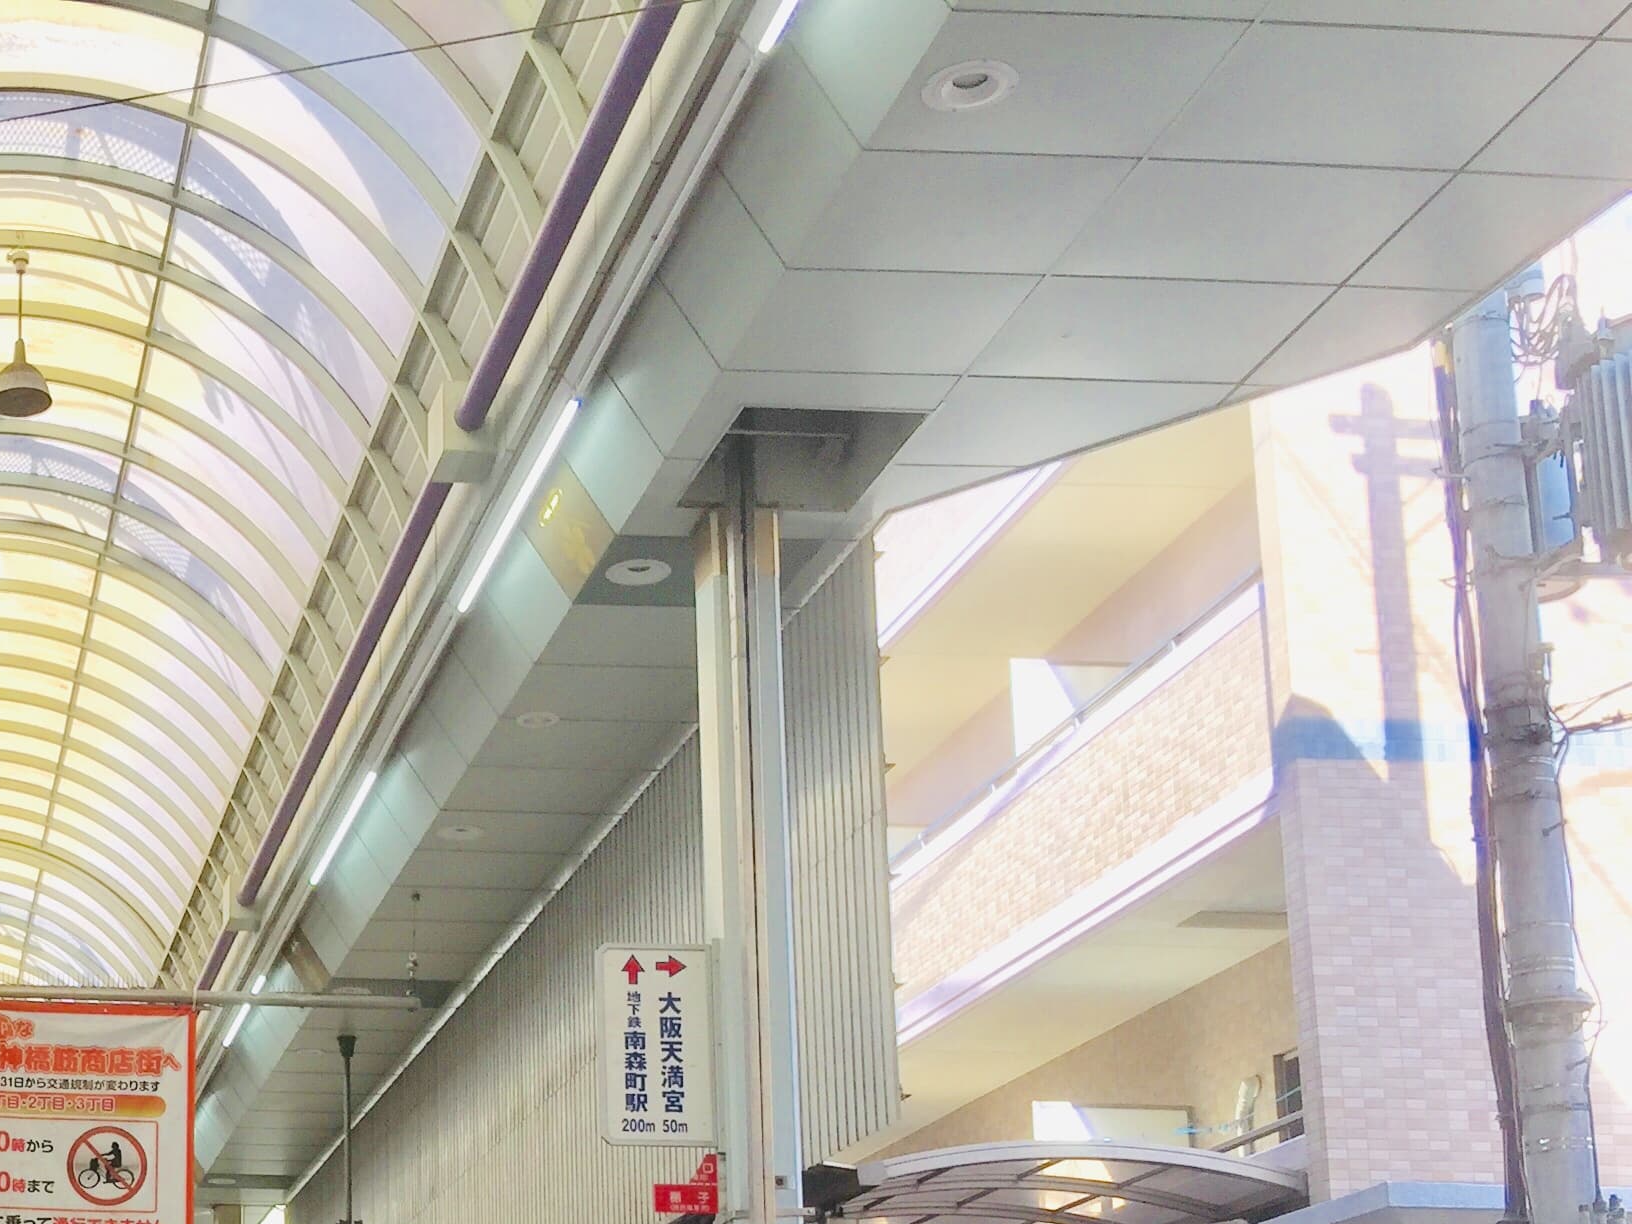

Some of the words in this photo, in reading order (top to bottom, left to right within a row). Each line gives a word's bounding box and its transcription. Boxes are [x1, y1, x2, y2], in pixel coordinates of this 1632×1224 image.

[658, 992, 684, 1113] 大阪天満宮
[622, 1119, 655, 1133] 200m
[663, 1119, 688, 1133] 50m
